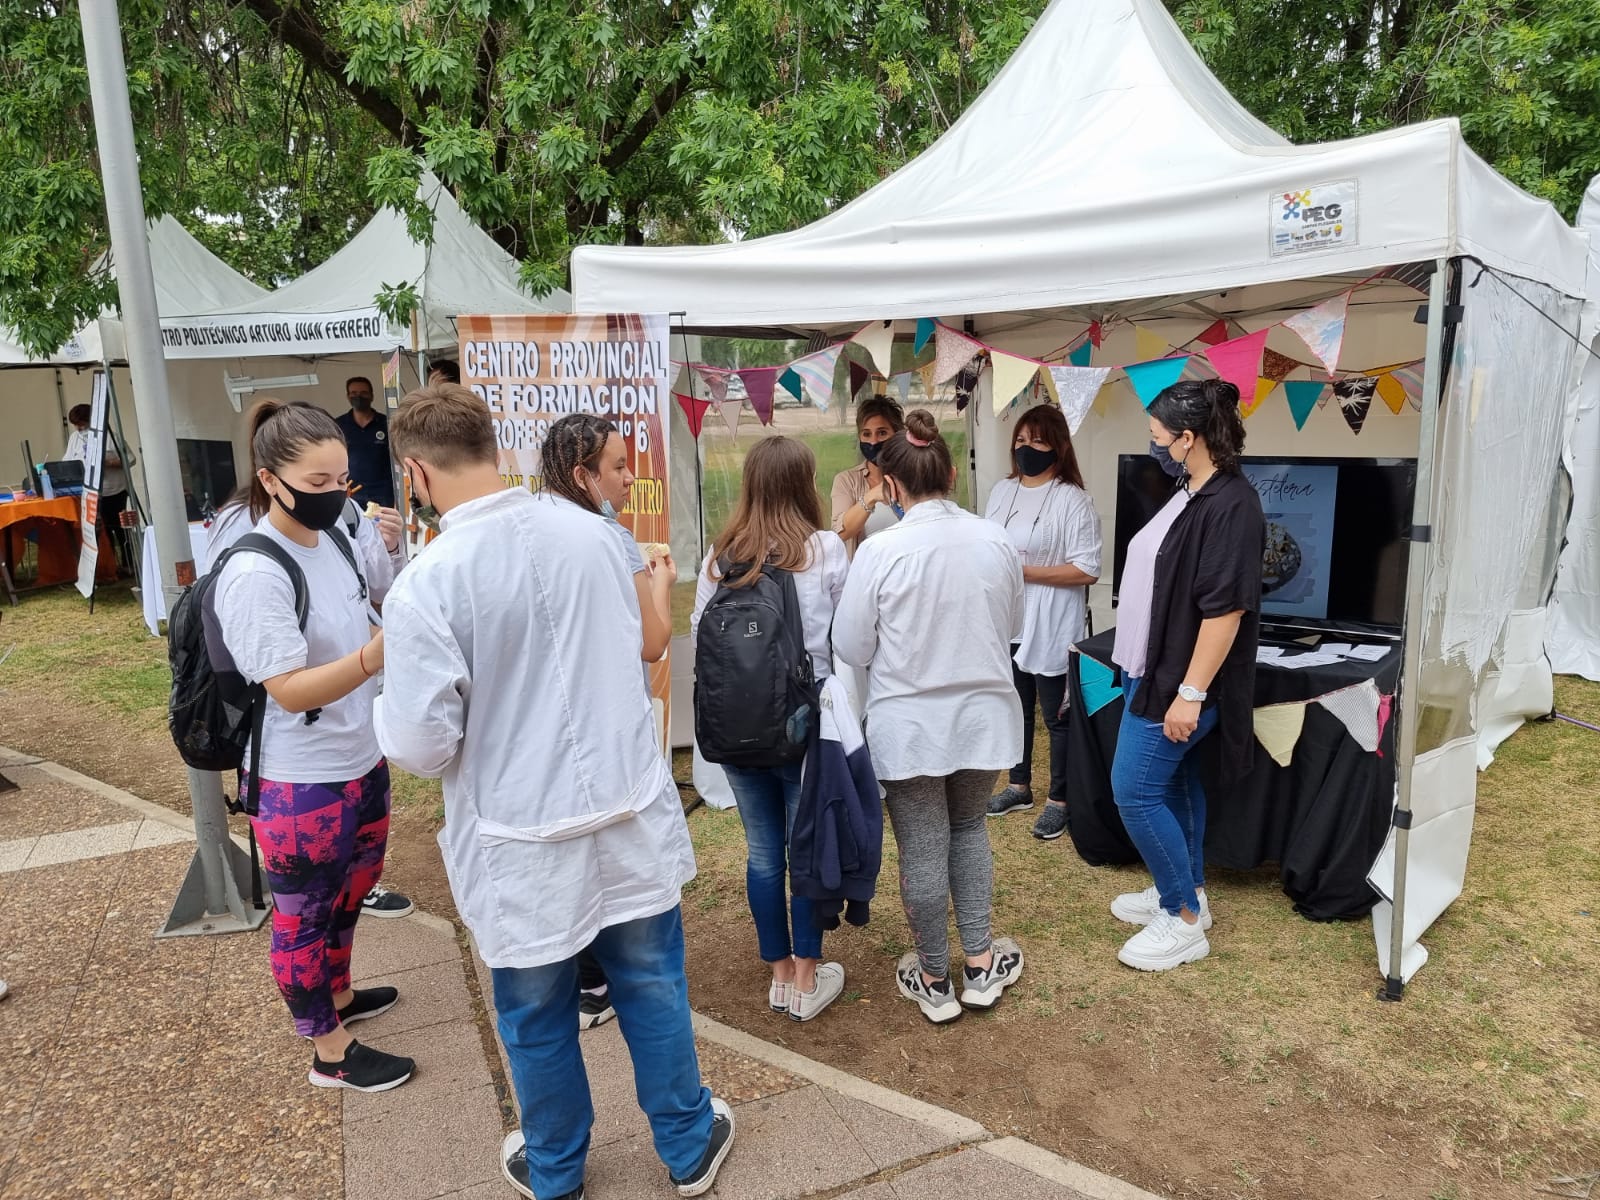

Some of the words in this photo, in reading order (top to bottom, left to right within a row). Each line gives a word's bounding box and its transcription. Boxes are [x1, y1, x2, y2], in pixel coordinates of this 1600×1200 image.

[1302, 203, 1342, 223] PEG
[160, 327, 182, 347] TRO
[182, 321, 248, 346] POLITÉCNICO
[249, 322, 291, 344] ARTURO
[294, 321, 324, 342] JUAN
[326, 316, 381, 339] FERRERO
[464, 341, 540, 379] CENTRO
[550, 340, 667, 379] PROVINCIAL
[471, 384, 504, 412] DE
[509, 384, 658, 415] FORMACION
[492, 418, 554, 450] ROFES
[637, 420, 649, 453] 6
